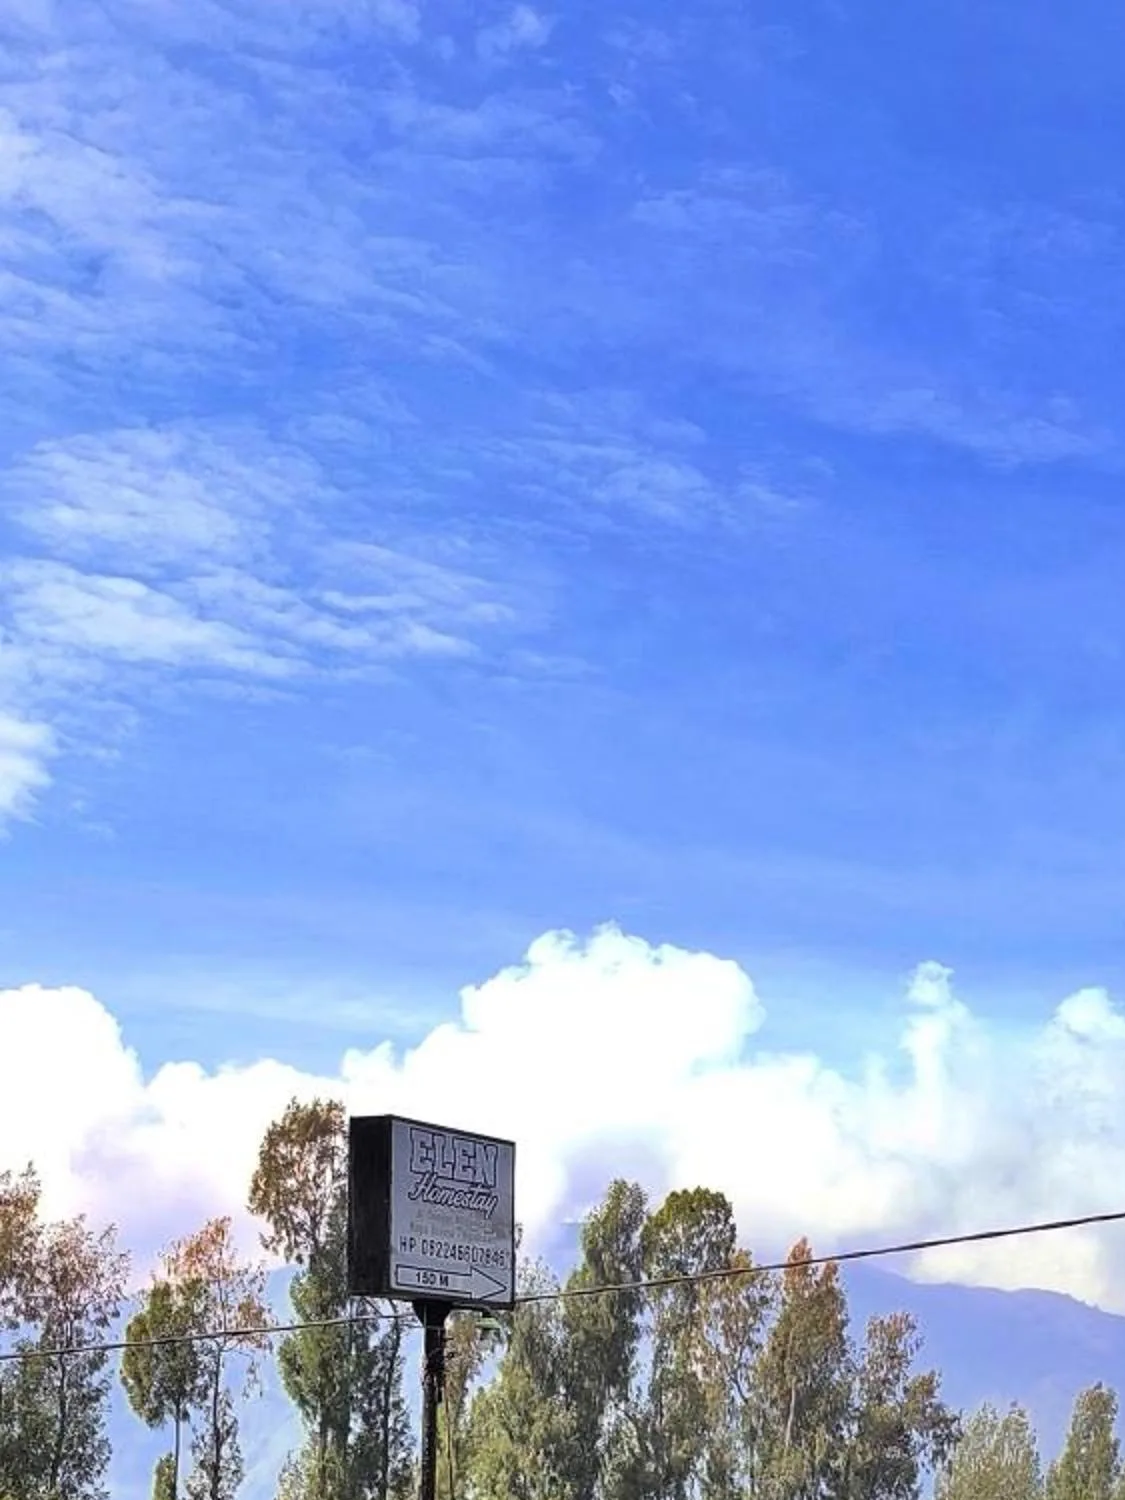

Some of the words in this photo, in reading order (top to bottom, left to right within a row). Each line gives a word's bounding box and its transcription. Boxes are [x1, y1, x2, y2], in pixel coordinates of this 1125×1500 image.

[410, 1127, 498, 1188] ELEN
[408, 1171, 498, 1220] Homestay
[399, 1236, 417, 1252] HP
[416, 1271, 436, 1285] 150
[440, 1274, 449, 1287] M
